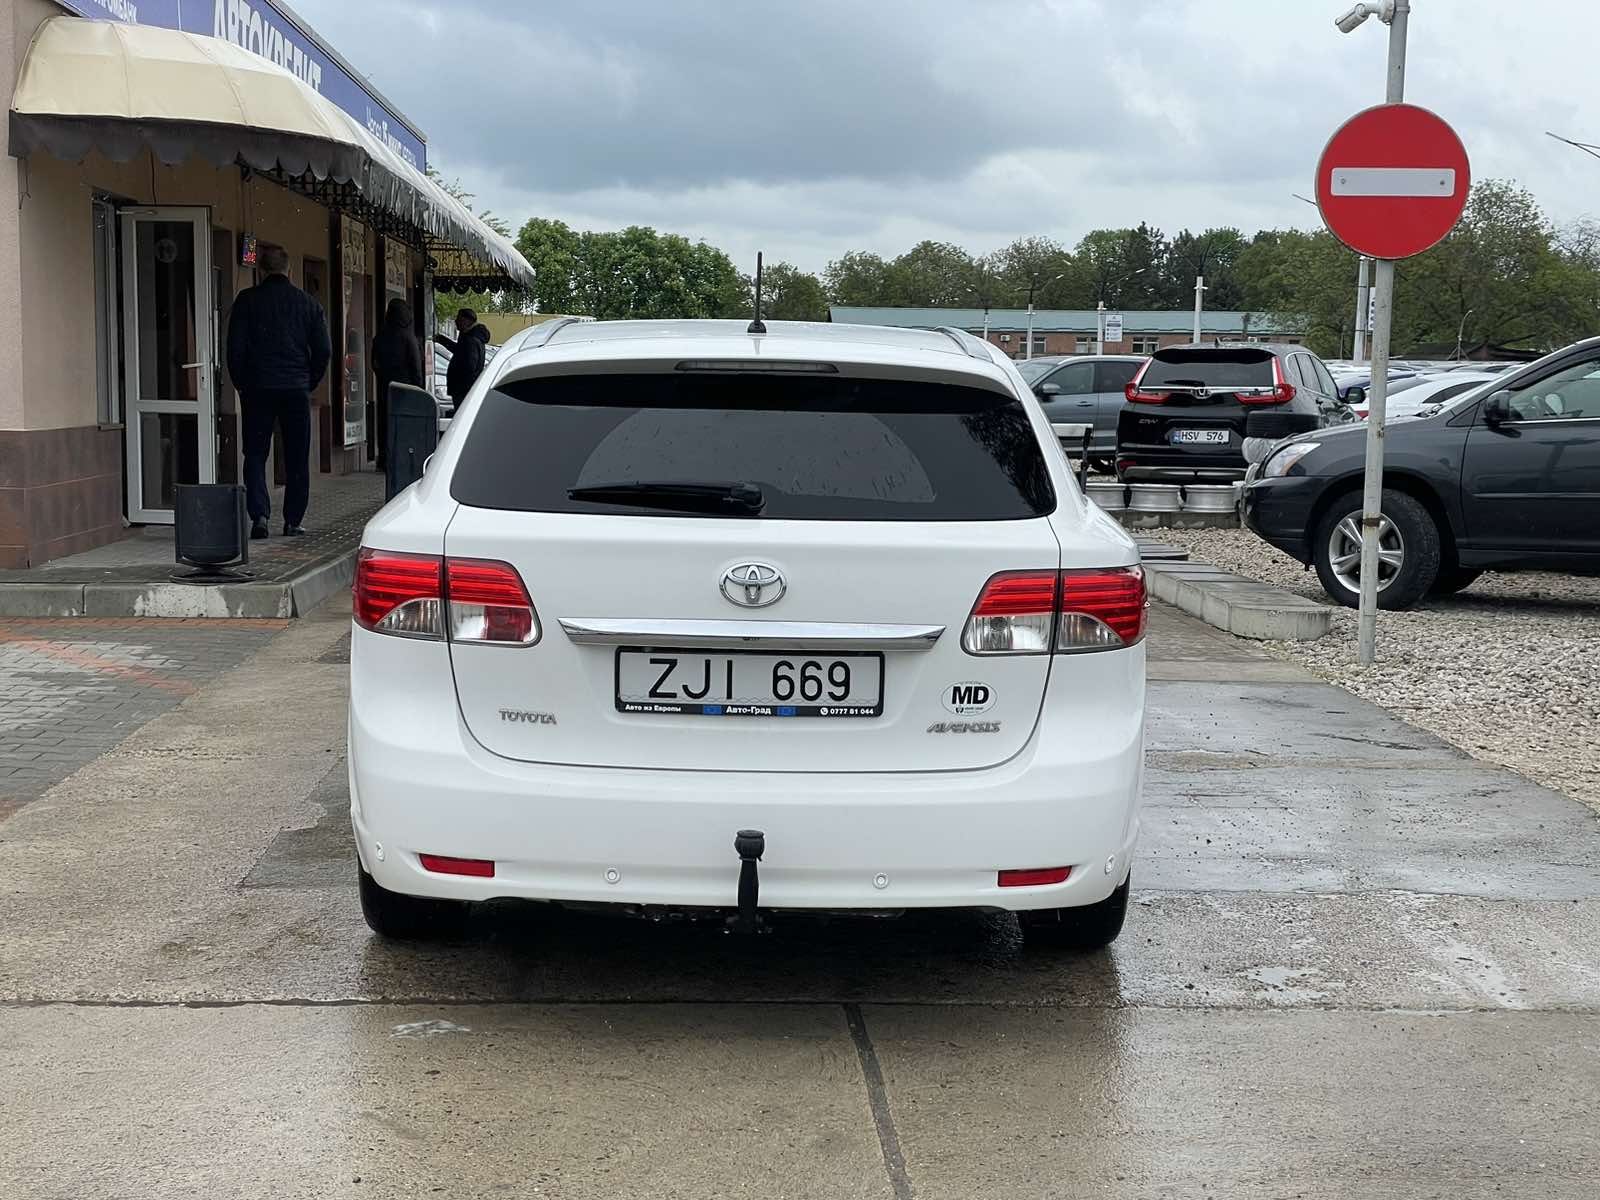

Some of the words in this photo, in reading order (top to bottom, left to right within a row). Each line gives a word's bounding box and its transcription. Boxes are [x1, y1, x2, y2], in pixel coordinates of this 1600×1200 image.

[1181, 431, 1200, 441] HSV
[1206, 431, 1224, 441] 576
[648, 657, 734, 700] ZJI
[772, 660, 851, 702] 669
[951, 685, 990, 705] MD
[654, 704, 682, 713] Европы
[726, 705, 772, 716] Авто-Град
[498, 710, 557, 725] TOYOTA
[926, 721, 1002, 734] AVENSIS
